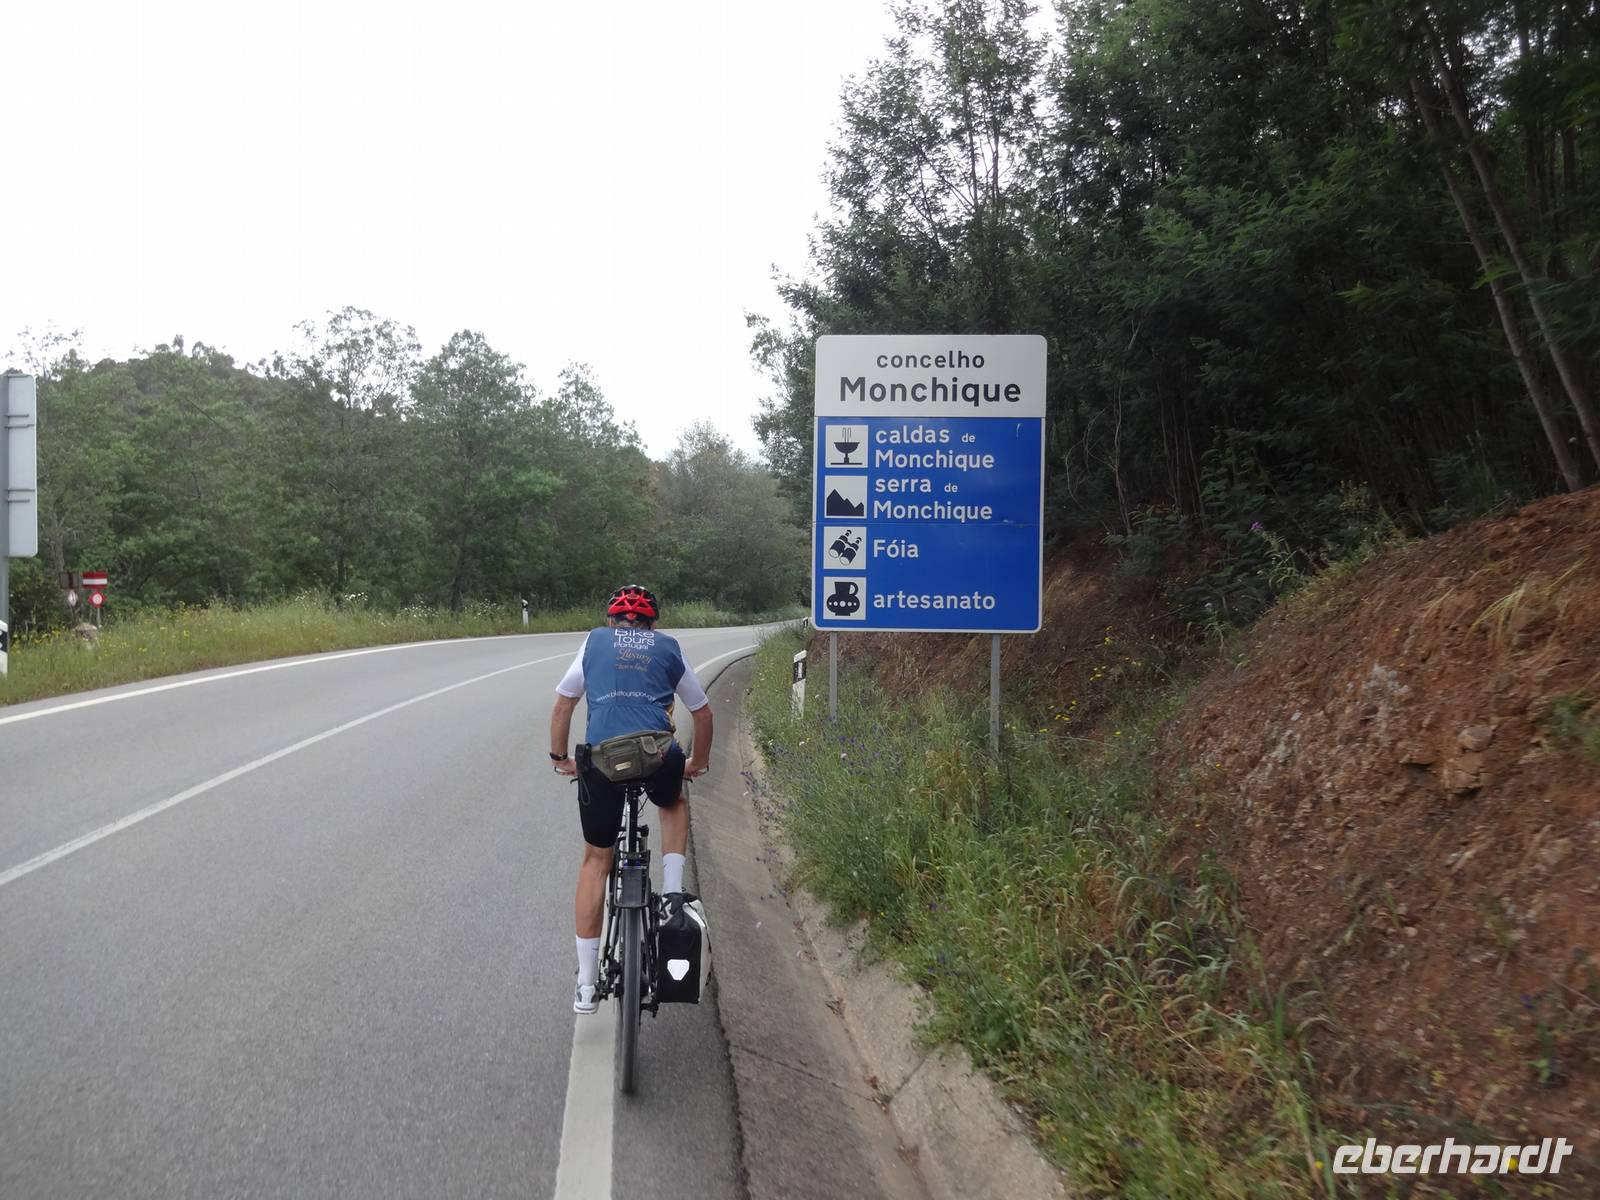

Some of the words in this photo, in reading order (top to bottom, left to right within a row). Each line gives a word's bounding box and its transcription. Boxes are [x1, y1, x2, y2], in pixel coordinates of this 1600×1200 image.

[877, 350, 985, 369] concelho
[840, 376, 1022, 407] Monchique
[875, 426, 950, 444] caldas
[961, 432, 976, 443] de
[875, 449, 995, 472] Monchique
[875, 477, 932, 494] serra
[944, 482, 958, 493] de
[873, 500, 993, 523] Monchique
[873, 539, 919, 558] Fóia
[873, 591, 996, 610] artesanato
[615, 628, 655, 639] Bike
[617, 634, 655, 647] Tours
[613, 642, 649, 650] Portugal
